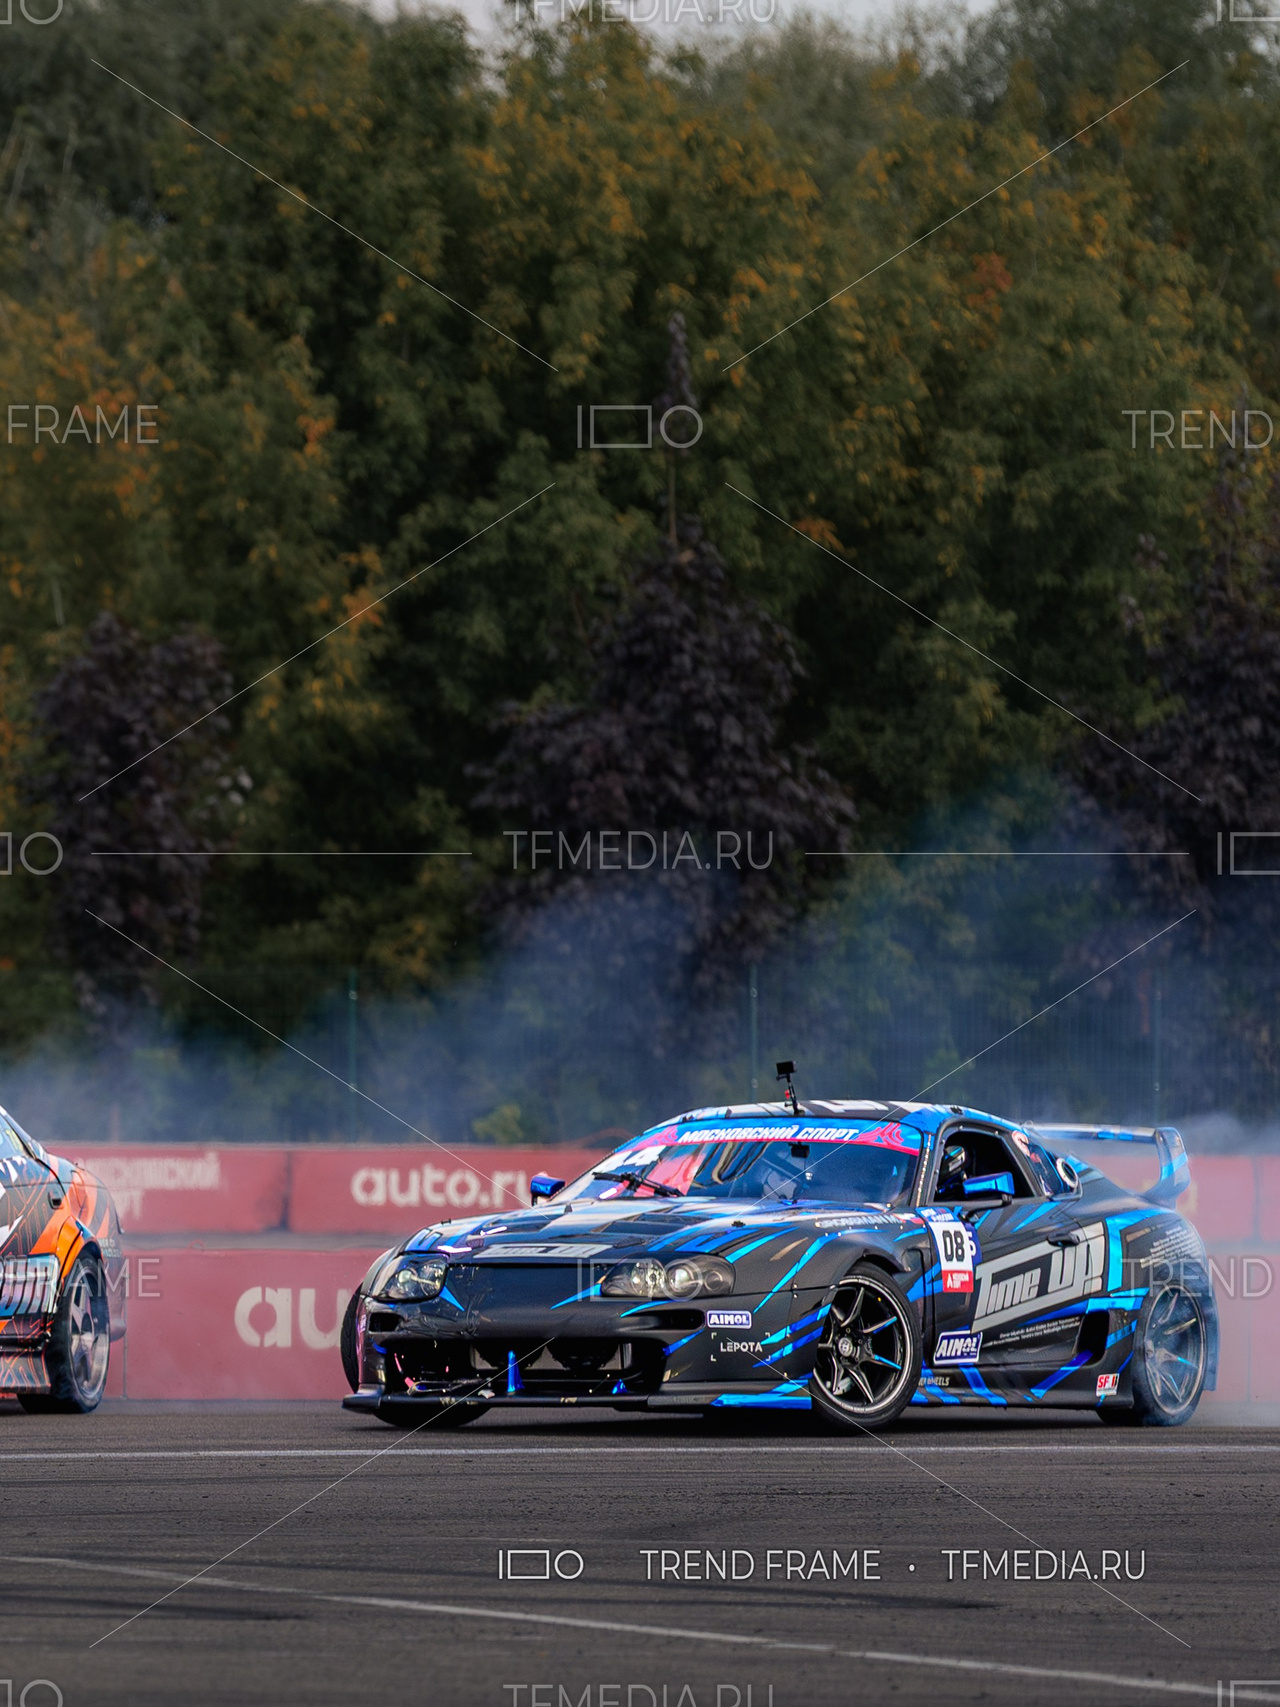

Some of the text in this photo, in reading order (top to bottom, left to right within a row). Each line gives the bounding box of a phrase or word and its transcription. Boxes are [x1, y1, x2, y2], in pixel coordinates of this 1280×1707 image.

[677, 1124, 860, 1144] МОСКОВСКИЙ СПОРТ
[942, 1230, 965, 1262] 08
[720, 1341, 763, 1353] LEPOTA
